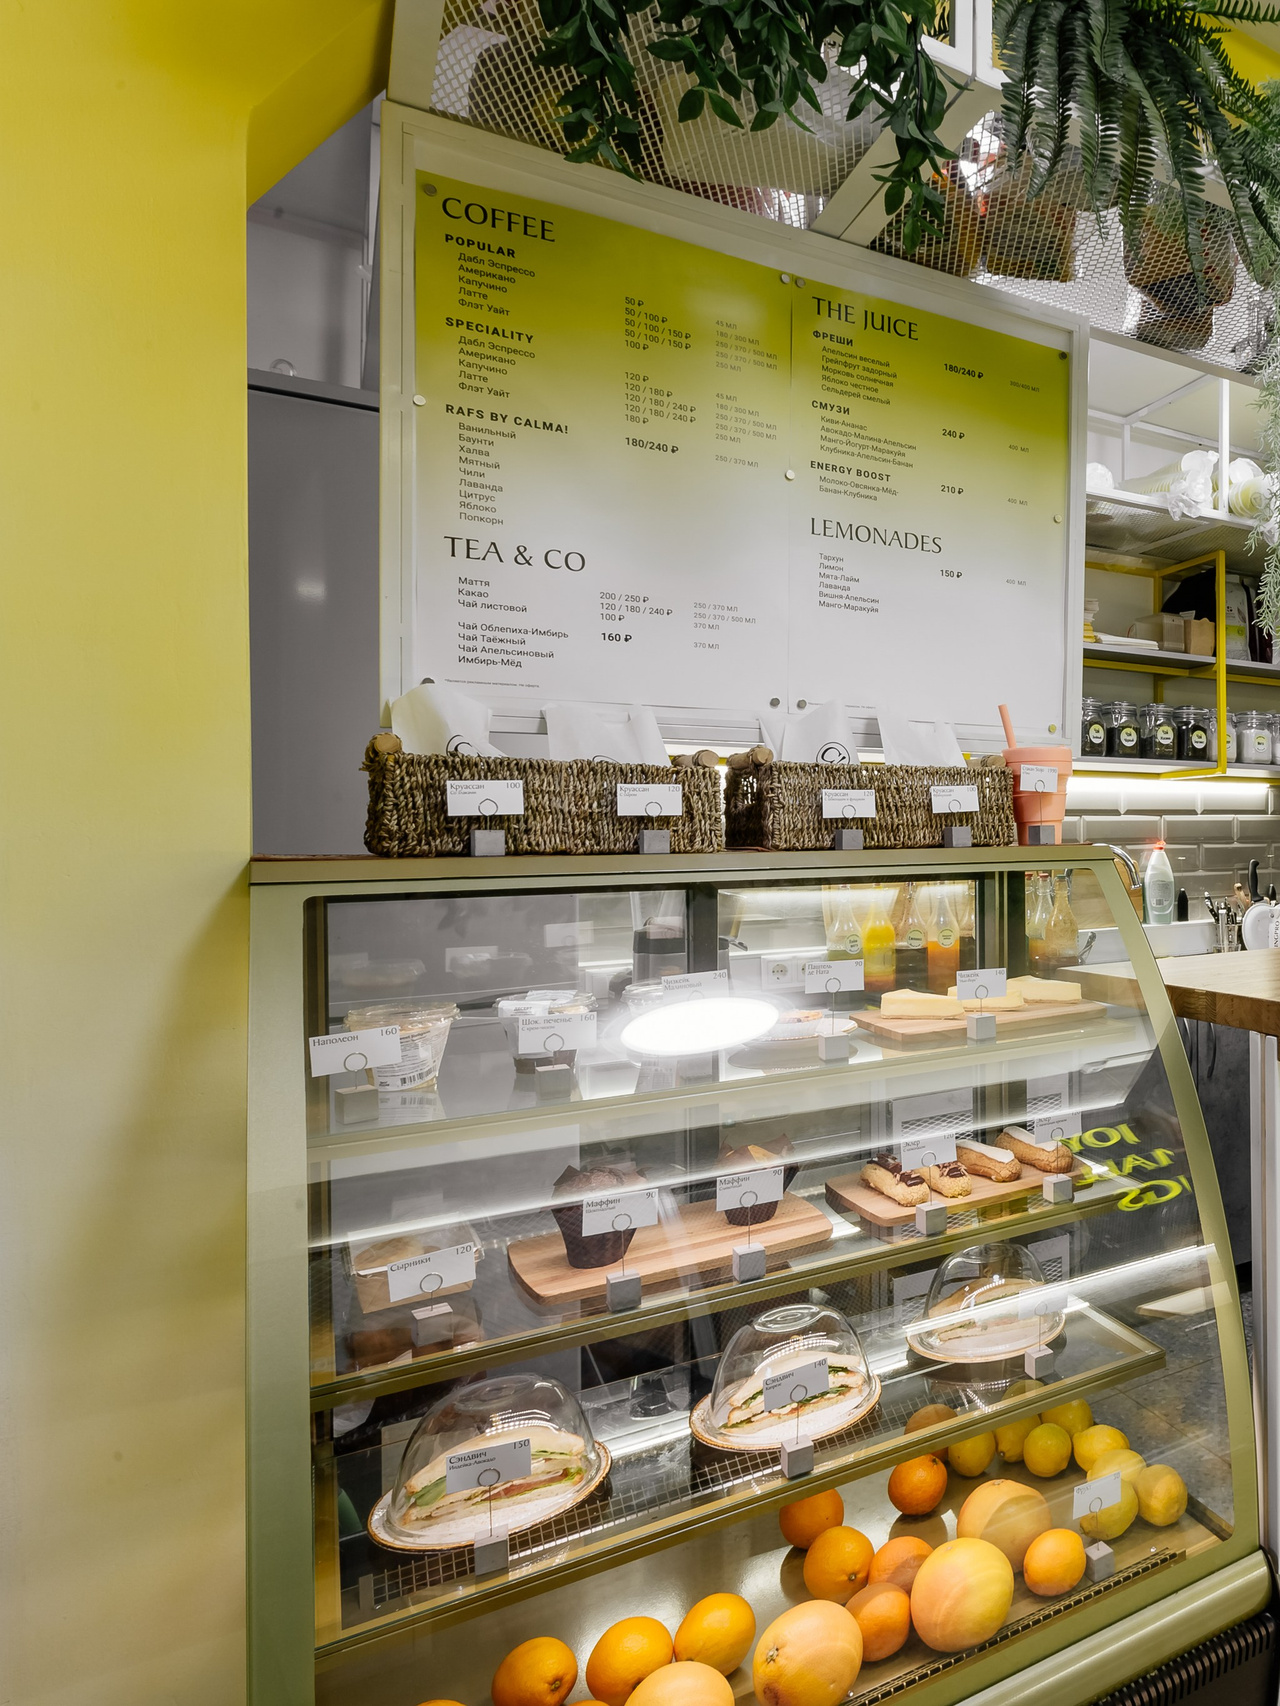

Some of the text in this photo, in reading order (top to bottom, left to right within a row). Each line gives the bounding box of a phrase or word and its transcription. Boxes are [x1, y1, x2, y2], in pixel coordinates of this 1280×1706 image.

[441, 197, 555, 243] COFFEE
[444, 233, 516, 259] POPULAR
[457, 252, 536, 278] Дабл Эспрессо
[457, 263, 516, 284] Американо
[458, 274, 508, 294] Капучино
[458, 286, 489, 301] Латте
[458, 298, 511, 317] Флэт Уайт
[624, 296, 636, 306] 50
[624, 306, 636, 317] 50
[643, 312, 660, 323] 100
[811, 296, 919, 341] THE JUICE
[445, 316, 534, 344] SPECIALITY
[715, 319, 725, 327] 45
[624, 339, 641, 350] 100
[812, 330, 854, 347] ФРЕШИ
[458, 335, 536, 359] Дабл Эспрессо
[458, 347, 516, 366] Американо
[821, 345, 890, 368] Апельсин веселый
[458, 358, 508, 376] Капучино
[821, 354, 898, 379] Грейпфрут задорный
[943, 363, 976, 378] 180/240
[458, 369, 489, 383] Латте
[624, 371, 641, 382] 120
[821, 364, 894, 388] Морковь солнечная
[458, 381, 510, 399] Флэт Уайт
[821, 374, 879, 394] Яблоко честное
[821, 383, 891, 406] Сельдерей смелый
[811, 399, 850, 416] СМУЗИ
[445, 403, 568, 435] RAFS BY CALMA!
[624, 413, 641, 424] 180
[820, 415, 868, 432] Киви-Ананас
[458, 421, 517, 440] Ванильный
[941, 428, 957, 439] 240
[458, 433, 494, 447] Баунти
[625, 437, 668, 453] 180/240
[820, 425, 917, 451] Авокадо-Малина-Апельсин
[458, 444, 490, 457] Халва
[820, 434, 906, 458] Манго-Йогурт-Маракуйя
[458, 455, 501, 470] Мятный
[819, 444, 914, 469] Клубника-Апельсин-Банан
[458, 466, 486, 479] Чили
[810, 460, 891, 482] ENERGY BOOST
[458, 478, 504, 493] Лаванда
[819, 475, 899, 497] Молоко-Овсянка-Мёд-
[940, 484, 956, 494] 210
[459, 489, 496, 503] Цитрус
[819, 484, 878, 502] Банан-Клубника
[459, 500, 497, 514] Яблоко
[459, 511, 504, 526] Попкорн
[811, 517, 942, 554] LEMONADES
[443, 535, 586, 572] TEA & CO
[818, 552, 844, 564] Тархун
[818, 562, 844, 572] Лимон
[940, 569, 955, 578] 150
[458, 576, 490, 587] Маття
[818, 571, 860, 583] Мята-Лайм
[458, 587, 489, 599] Какао
[818, 581, 851, 592] Лаванда
[818, 590, 880, 604] Вишня-Апельсин
[457, 599, 528, 613] Чай листовой
[818, 599, 879, 614] Манго-Маракуйя
[458, 621, 569, 639] Чай Облепиха-Имбирь
[601, 632, 621, 642] 160
[458, 632, 526, 646] Чай Таёжный
[458, 644, 555, 659] Чай Апельсиновый
[458, 655, 523, 669] Имбирь-Мёд
[450, 783, 485, 792] Круассан
[619, 785, 650, 793] Круассан
[668, 785, 680, 793] 120
[824, 791, 849, 799] Круассан
[713, 971, 727, 980] 240
[663, 982, 702, 991] Малиновый
[521, 1018, 541, 1026] Шок.
[380, 1027, 398, 1036] 160
[312, 1035, 359, 1047] Наполеон
[719, 1176, 750, 1186] Маффин
[645, 1191, 656, 1199] 90
[585, 1198, 621, 1208] Маффин
[455, 1245, 472, 1255] 120
[390, 1257, 431, 1271] Сырники
[814, 1358, 827, 1368] 140
[513, 1439, 530, 1450] 150
[448, 1451, 487, 1464] Сэндвич
